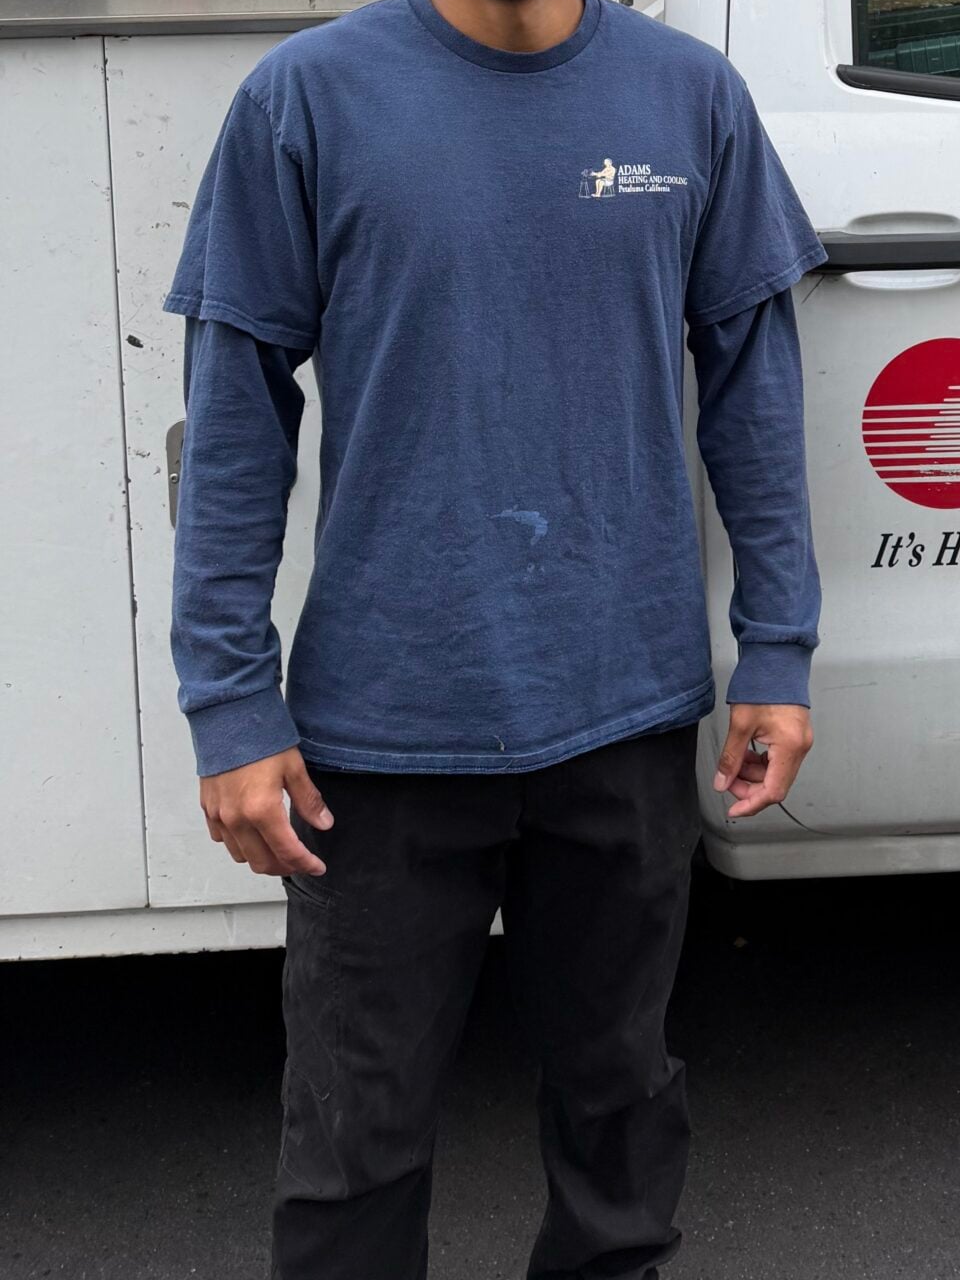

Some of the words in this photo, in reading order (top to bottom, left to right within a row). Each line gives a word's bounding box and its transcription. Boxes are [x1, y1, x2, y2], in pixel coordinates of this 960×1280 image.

[618, 164, 651, 176] ADAMS
[618, 175, 648, 185] HEATING
[649, 176, 663, 184] AND
[663, 175, 688, 186] COOLING
[645, 184, 671, 193] California
